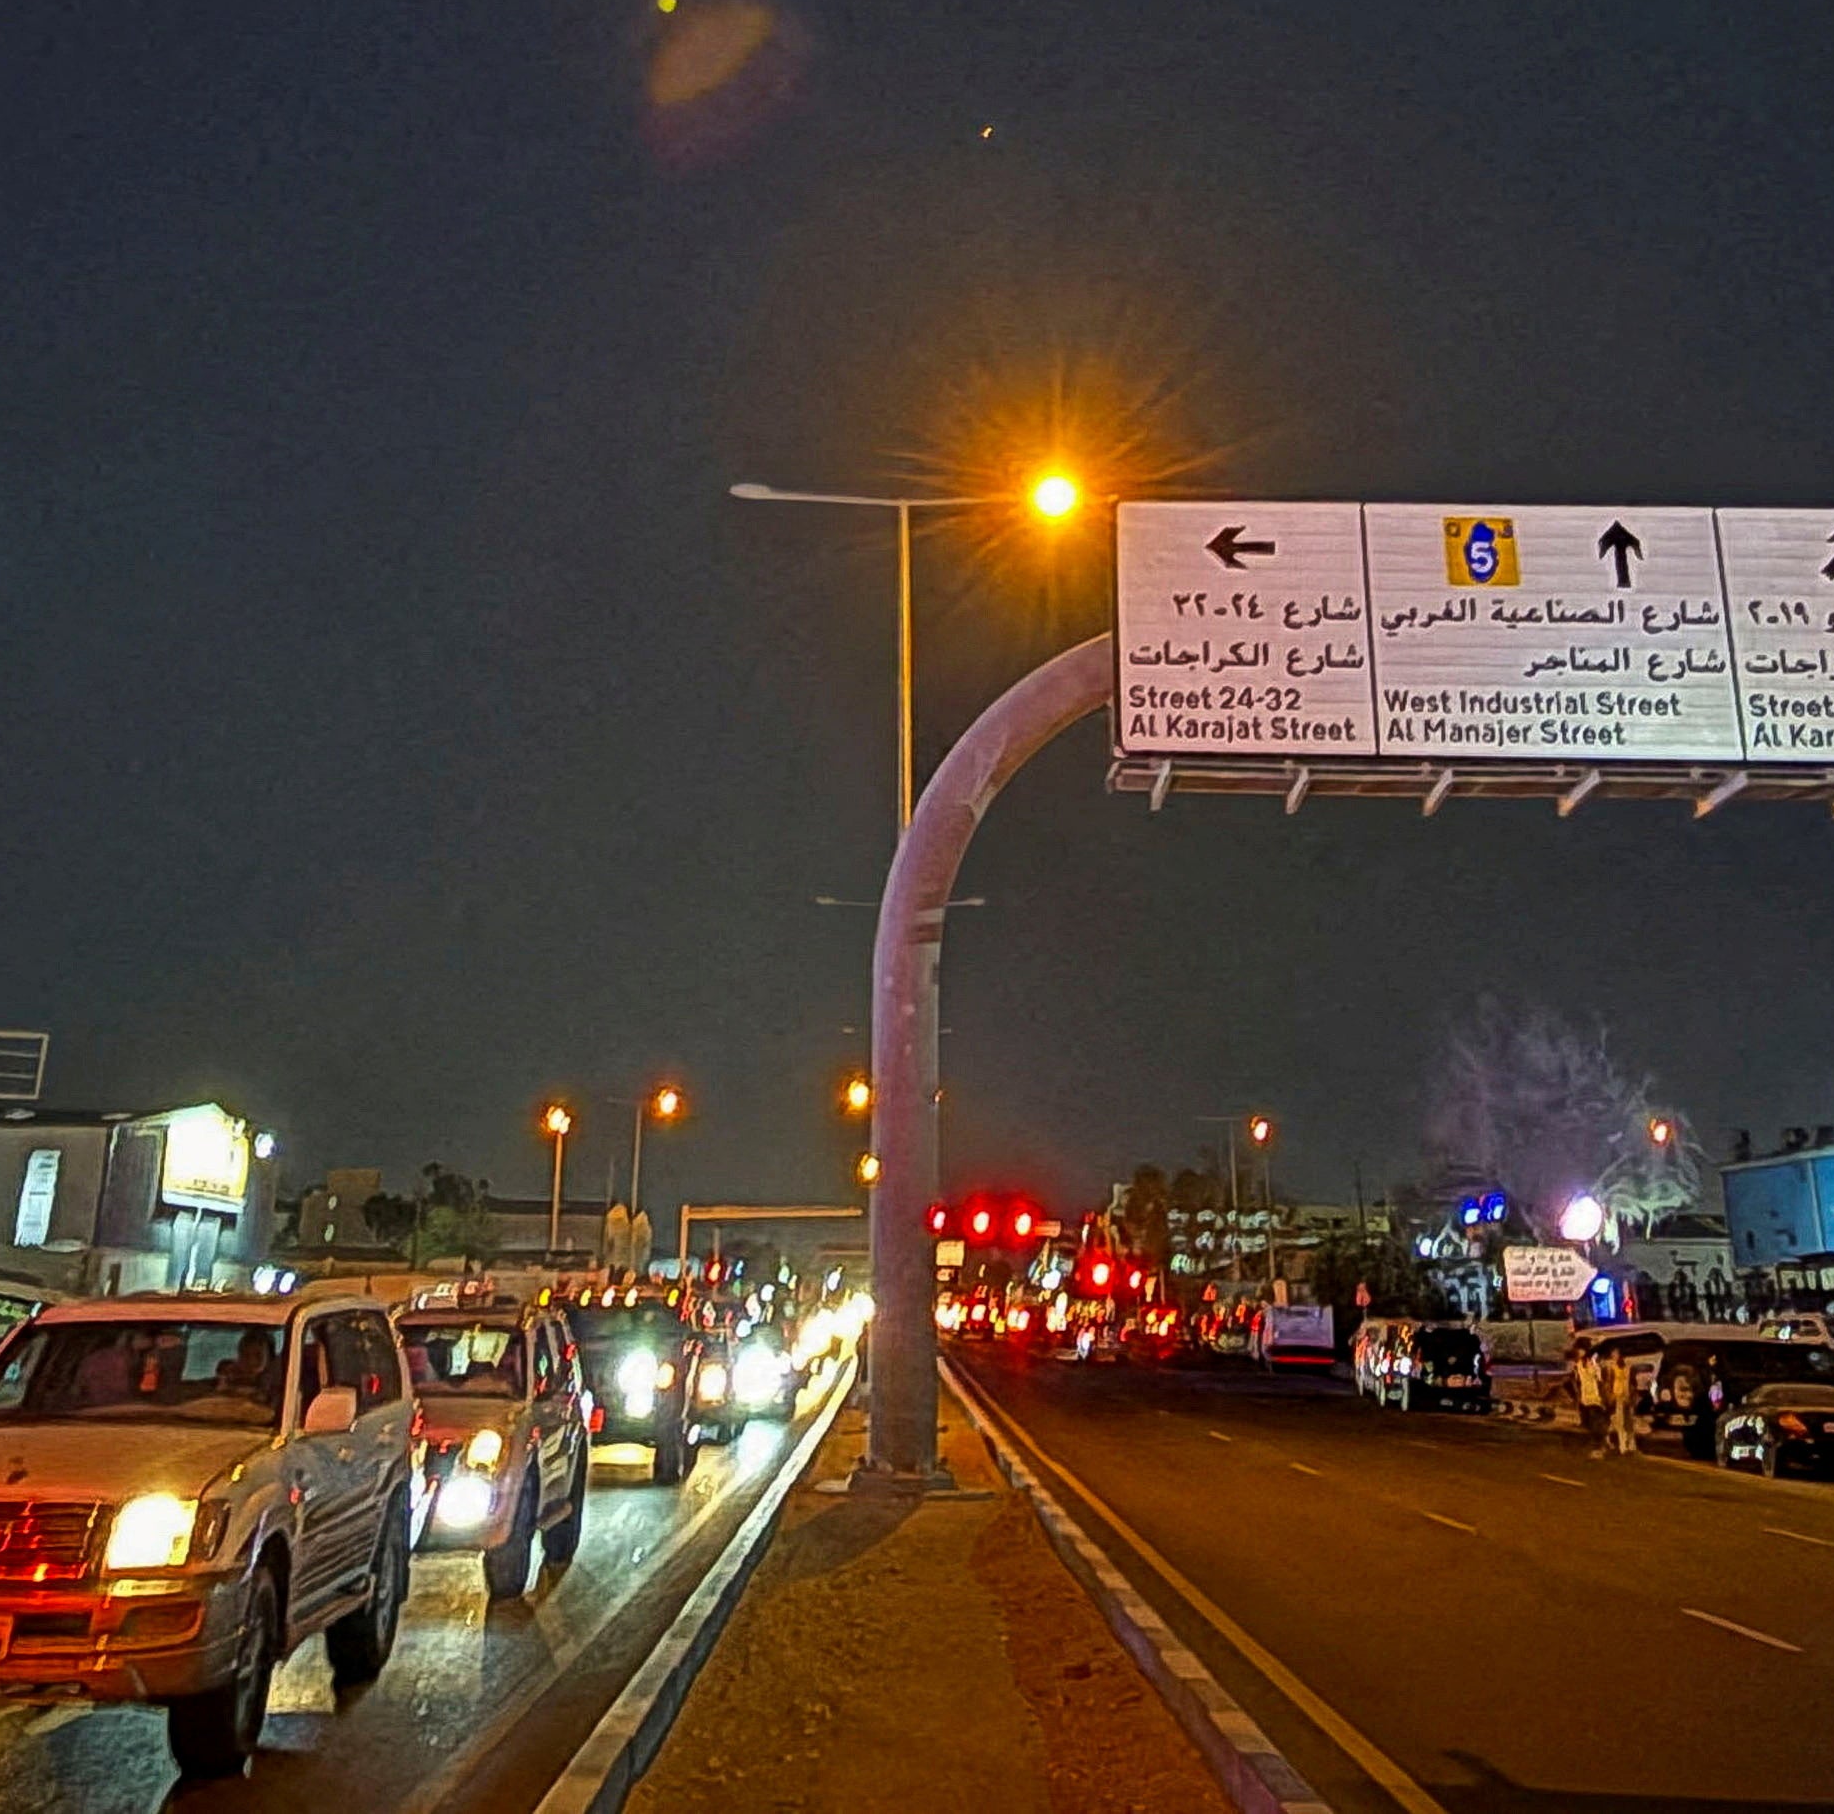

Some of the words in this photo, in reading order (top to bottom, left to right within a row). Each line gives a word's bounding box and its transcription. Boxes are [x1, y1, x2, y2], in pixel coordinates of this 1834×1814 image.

[1471, 541, 1493, 573] 5
[1283, 595, 1362, 629] شارع
[1381, 598, 1477, 637] الغربي
[1491, 599, 1624, 629] الصناعية
[1642, 600, 1720, 634] شارع
[1129, 640, 1269, 673] الكراجات
[1286, 643, 1364, 677] شارع
[1523, 647, 1630, 678] المناجر
[1648, 648, 1726, 682] شارع
[1129, 685, 1212, 710] Street
[1219, 686, 1302, 711] 24-32
[1384, 689, 1452, 714] West
[1460, 690, 1589, 716] Industrial
[1596, 691, 1682, 716] Street
[1129, 713, 1157, 738] Al
[1166, 714, 1263, 744] Karajat
[1270, 716, 1357, 742] Street
[1387, 717, 1415, 742] Al
[1423, 718, 1531, 747] Manajer
[1539, 718, 1627, 745] Street
[1754, 722, 1782, 748] Al
